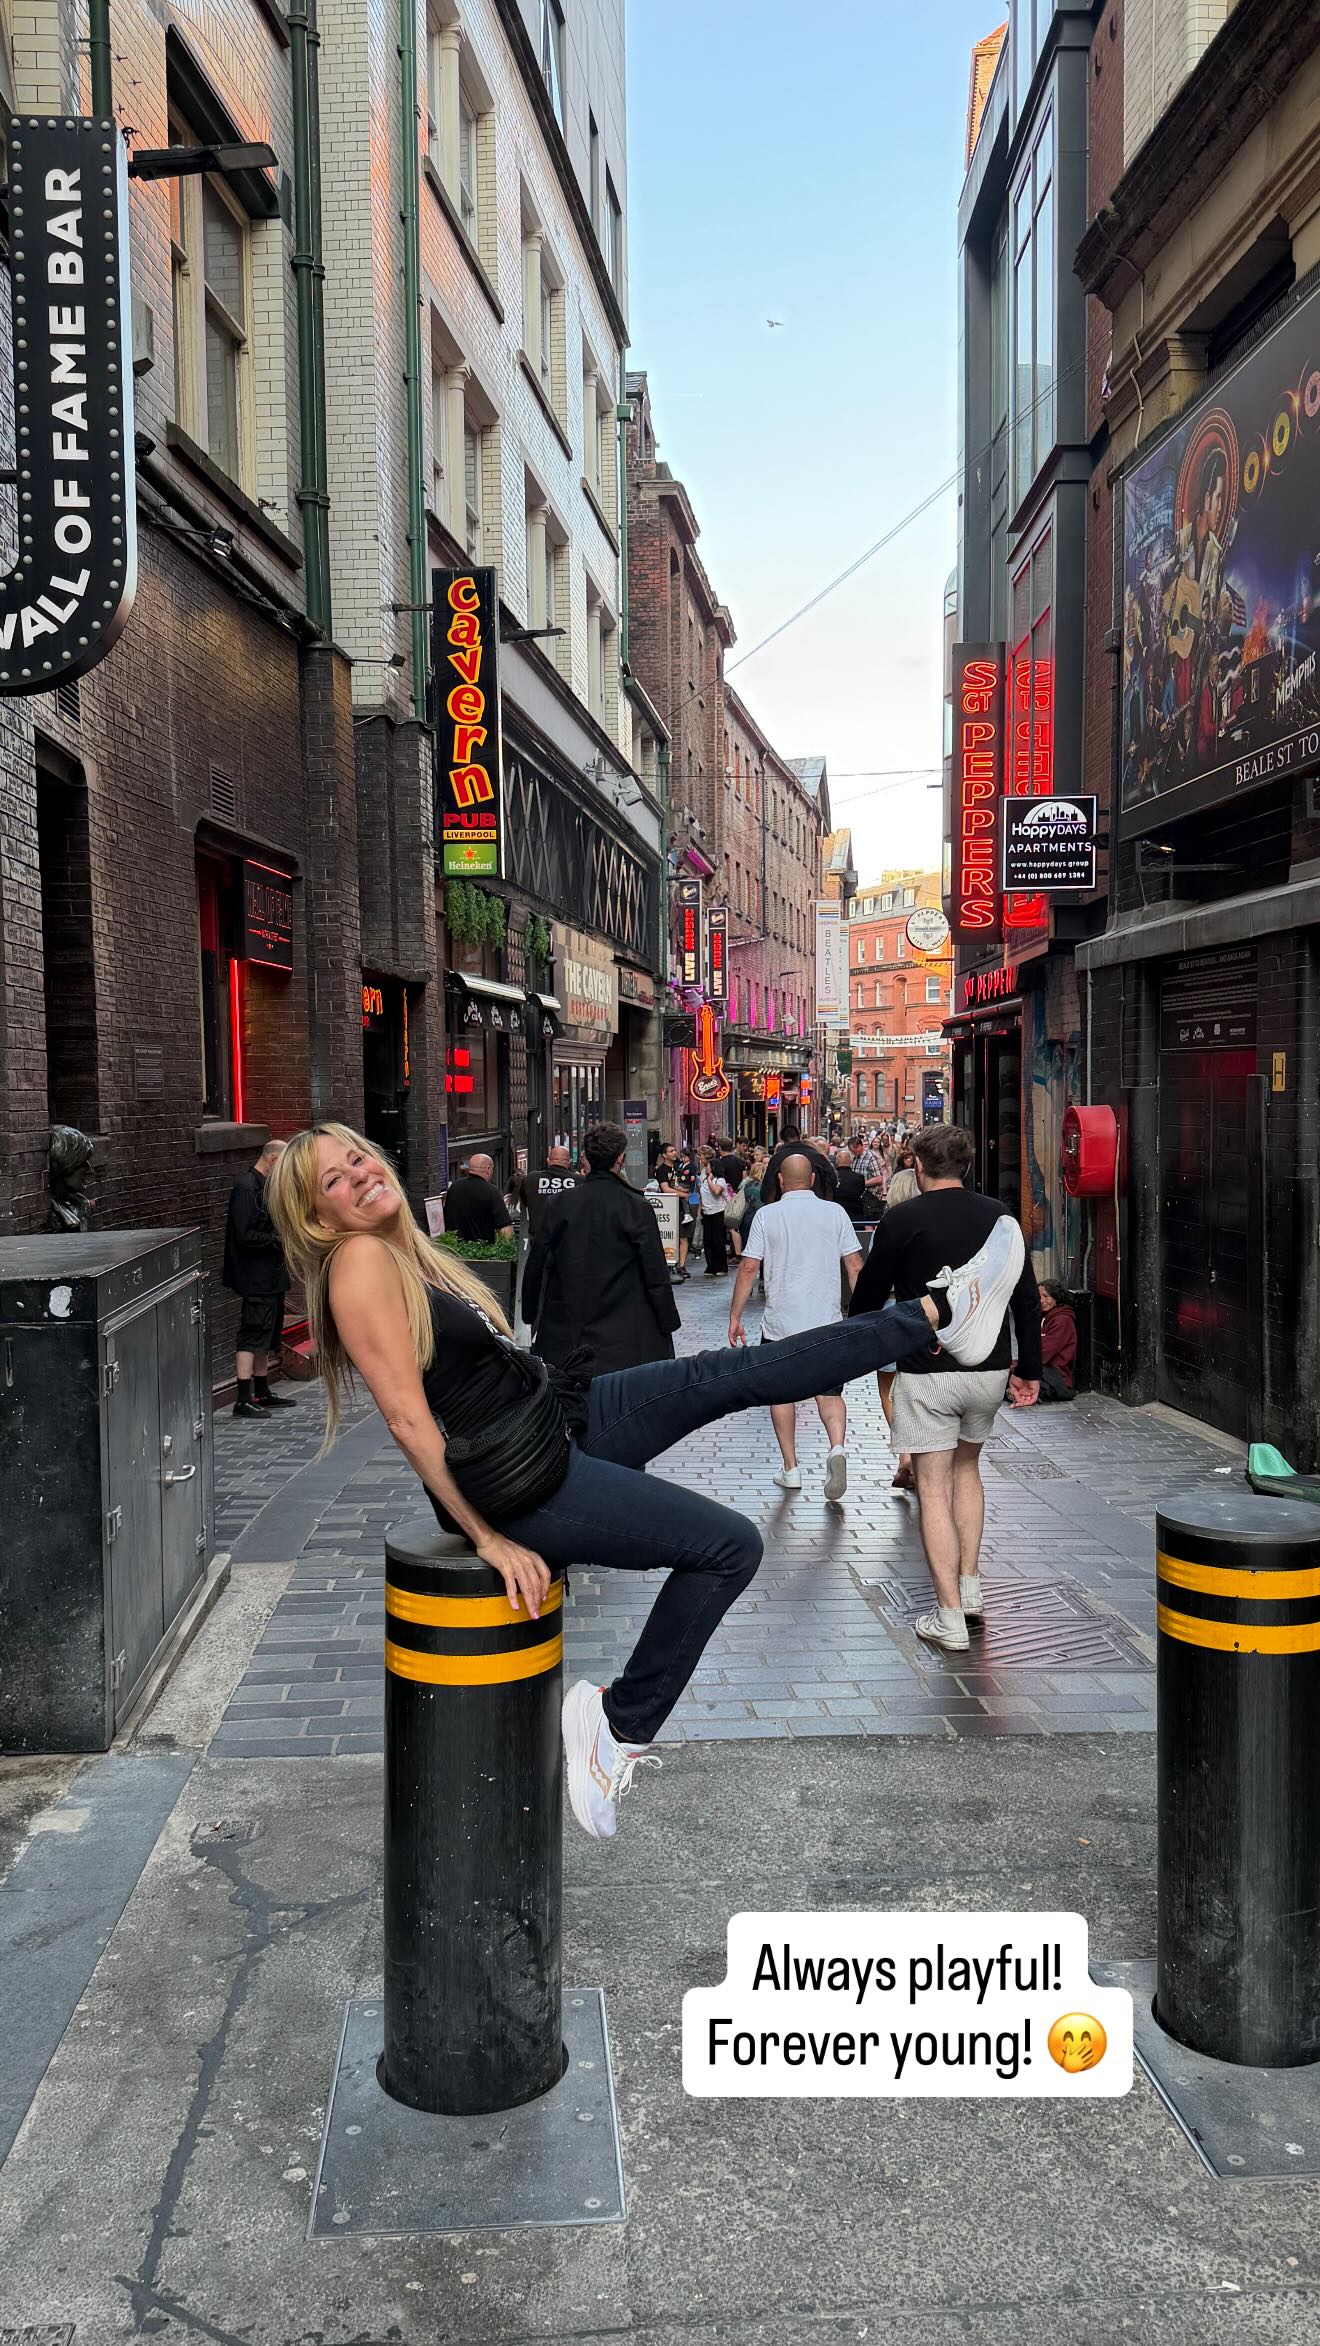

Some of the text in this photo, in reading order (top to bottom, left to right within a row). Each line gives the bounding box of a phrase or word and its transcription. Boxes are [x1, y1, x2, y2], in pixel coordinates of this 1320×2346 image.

[44, 167, 84, 285] BAR
[48, 305, 90, 461] FAME
[54, 479, 92, 554] OF
[447, 577, 494, 808] cavern
[1276, 650, 1316, 712] MEMPHIS
[1235, 732, 1319, 786] BEALE ST TO
[443, 812, 497, 828] PUB
[960, 722, 996, 928] PEPPERS
[448, 861, 493, 870] Heineken
[1008, 841, 1092, 853] APARTMENTS
[684, 908, 695, 950] MUSIC
[713, 932, 722, 968] MUSIC
[563, 958, 582, 996] THE
[582, 965, 612, 1005] CAVERN
[684, 952, 696, 981] LIVE
[713, 970, 723, 996] LIVE
[824, 930, 832, 995] BEATLES
[538, 1177, 575, 1189] DSG
